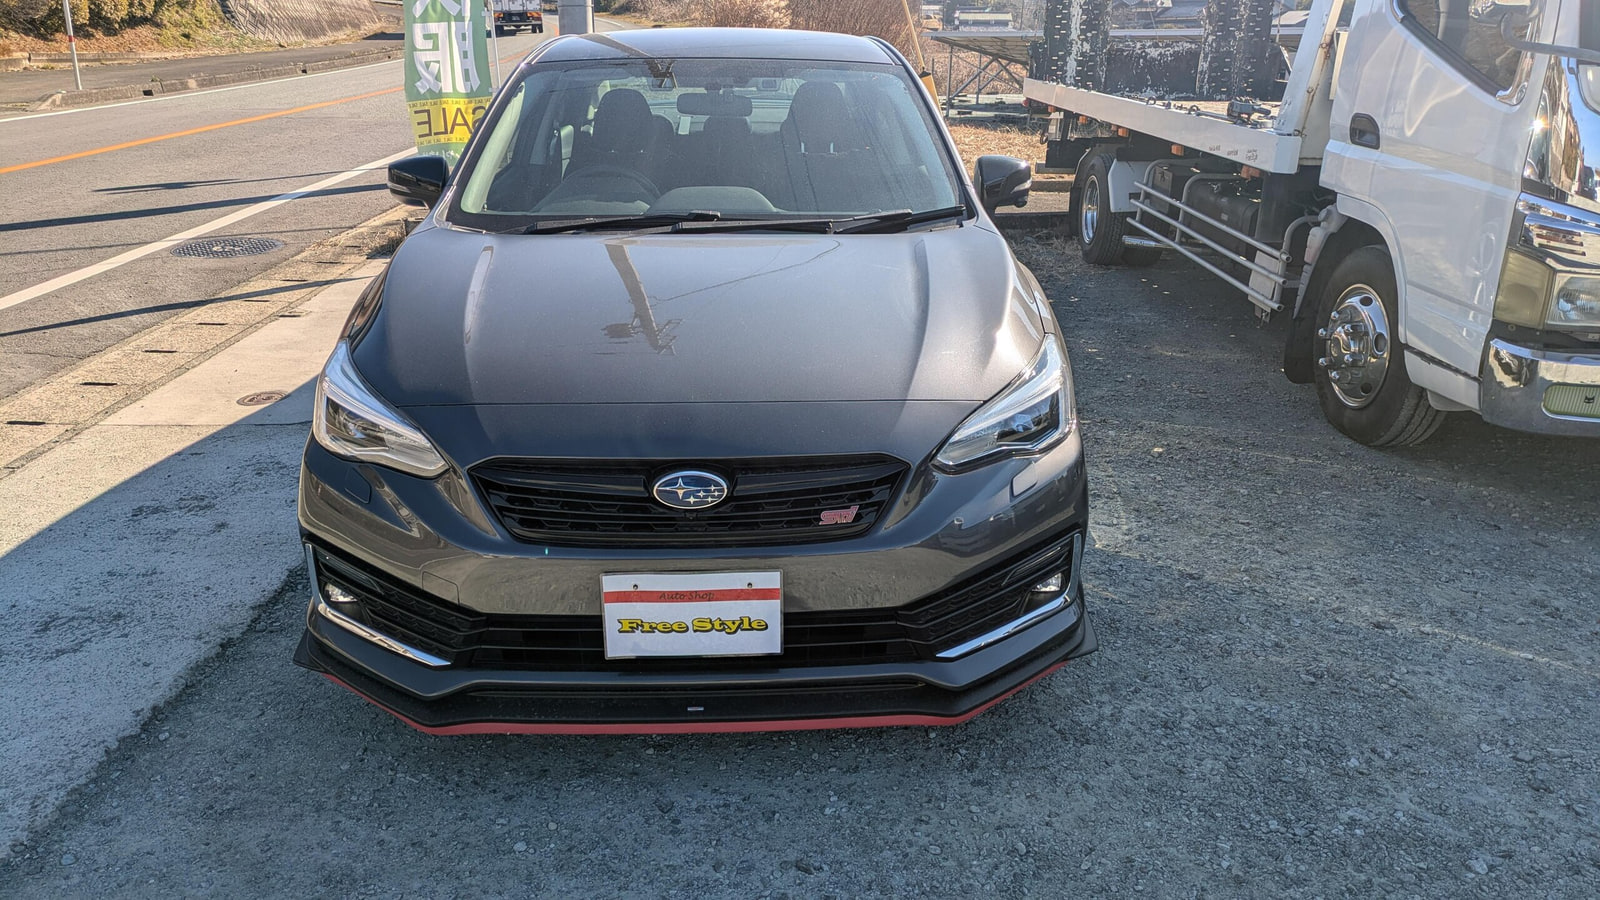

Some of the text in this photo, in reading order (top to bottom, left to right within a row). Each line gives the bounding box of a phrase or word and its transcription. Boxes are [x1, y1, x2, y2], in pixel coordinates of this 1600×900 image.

[659, 591, 715, 601] Auto Shop
[618, 616, 769, 635] Free Style
